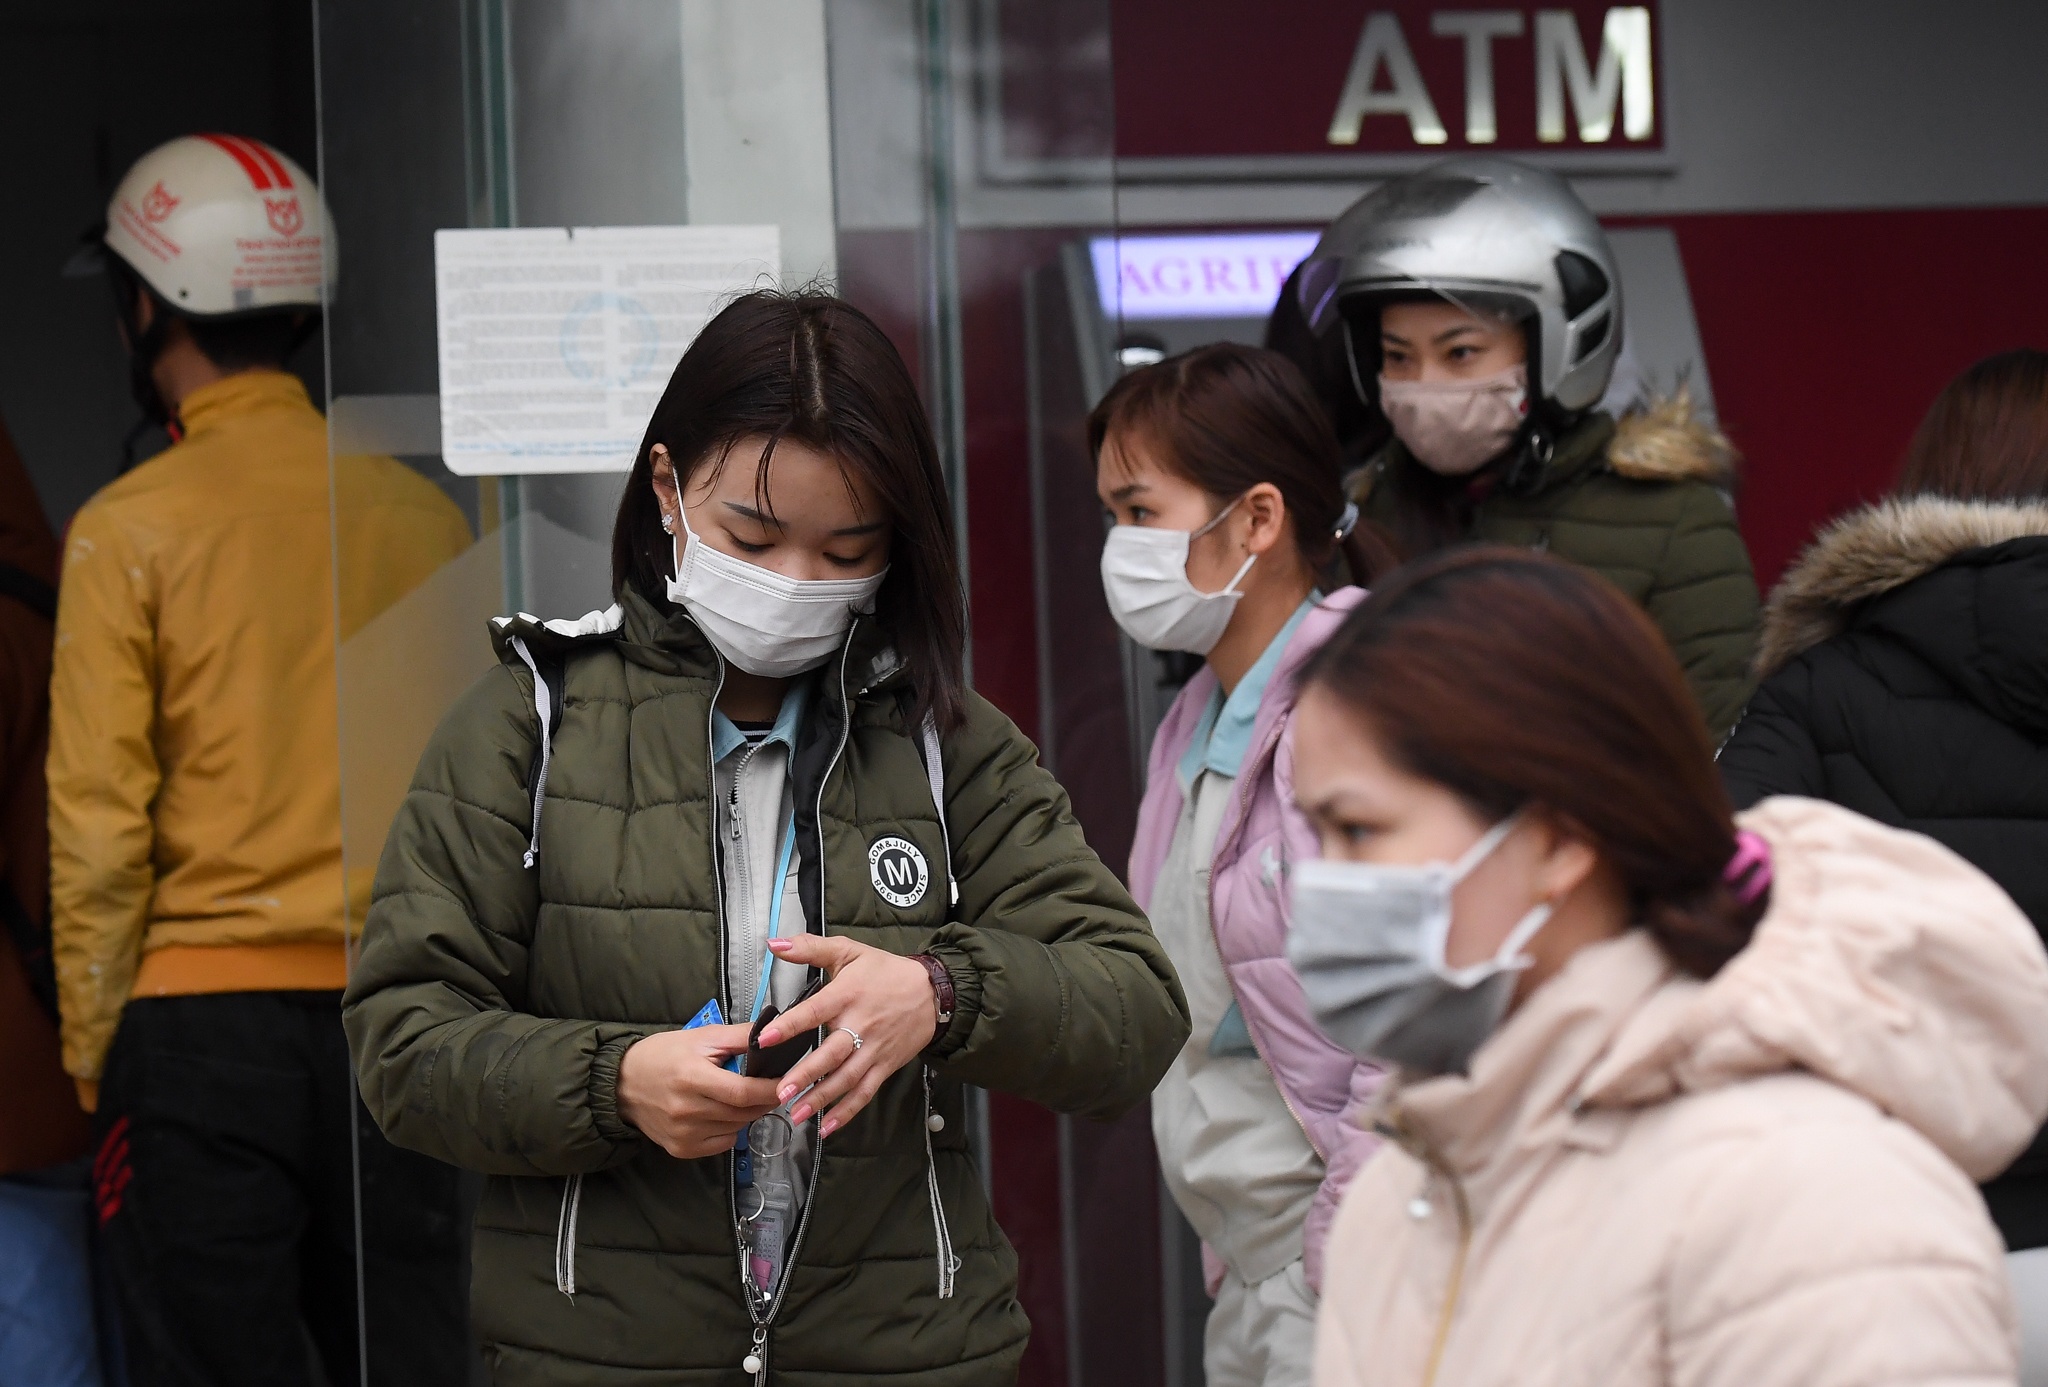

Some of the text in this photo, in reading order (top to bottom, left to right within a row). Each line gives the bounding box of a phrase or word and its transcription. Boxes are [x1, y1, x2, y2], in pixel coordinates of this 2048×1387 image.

[1327, 5, 1654, 145] ATM
[883, 857, 914, 886] M
[874, 874, 927, 905] SINCE 1998
